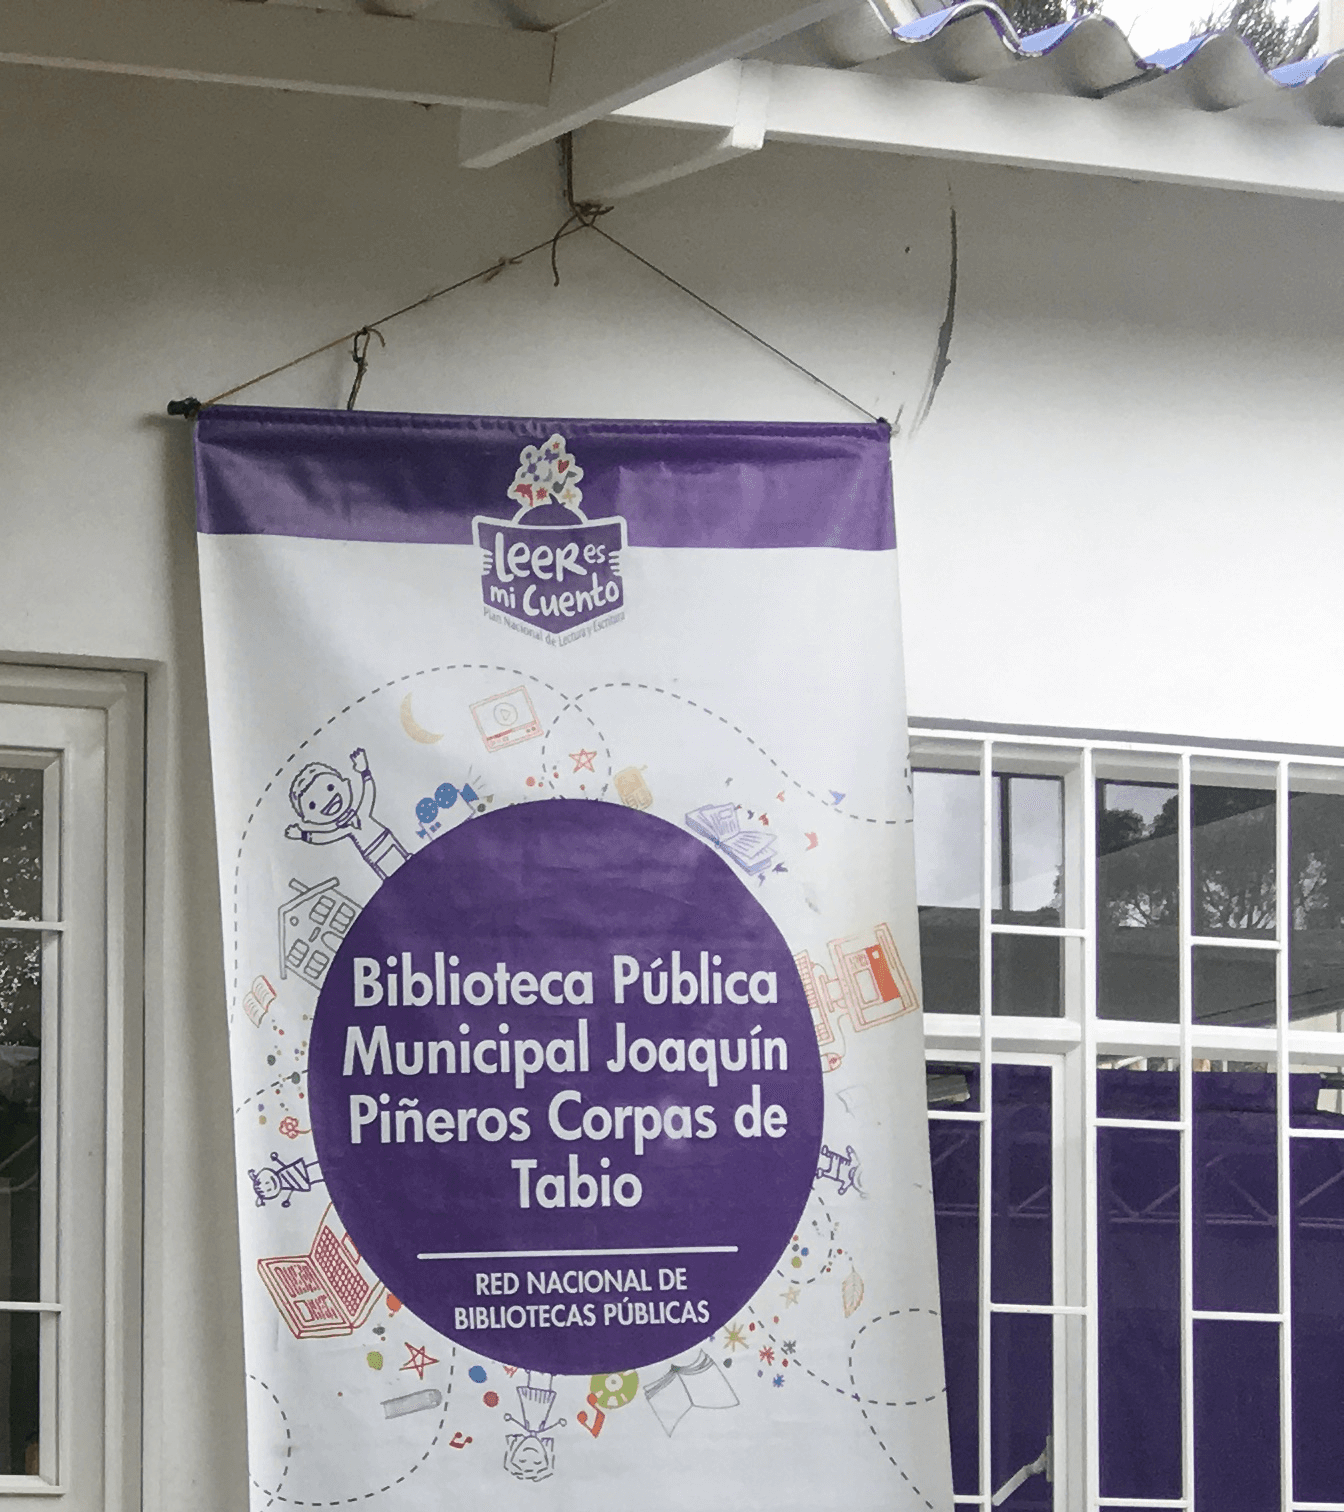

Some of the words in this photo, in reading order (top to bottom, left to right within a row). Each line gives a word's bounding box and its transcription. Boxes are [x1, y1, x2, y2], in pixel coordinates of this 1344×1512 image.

[583, 544, 606, 564] es
[490, 585, 516, 609] mi
[522, 572, 620, 617] Cuento
[483, 606, 502, 624] Plan
[504, 616, 543, 641] Nacional
[545, 633, 557, 647] de
[354, 951, 594, 1007] Biblioteca
[613, 950, 778, 1005] Pública
[343, 1018, 590, 1088] Municipal
[606, 1022, 788, 1087] Joaquín
[349, 1094, 531, 1143] Piñeros
[548, 1090, 716, 1155] Corpas
[734, 1085, 788, 1138] de
[512, 1154, 642, 1208] Tabio
[476, 1272, 519, 1296] RED
[527, 1269, 651, 1294] NACIONAL
[660, 1268, 687, 1290] DE
[455, 1303, 596, 1330] BIBLIOTECAS
[604, 1297, 710, 1327] PÚBLICAS
